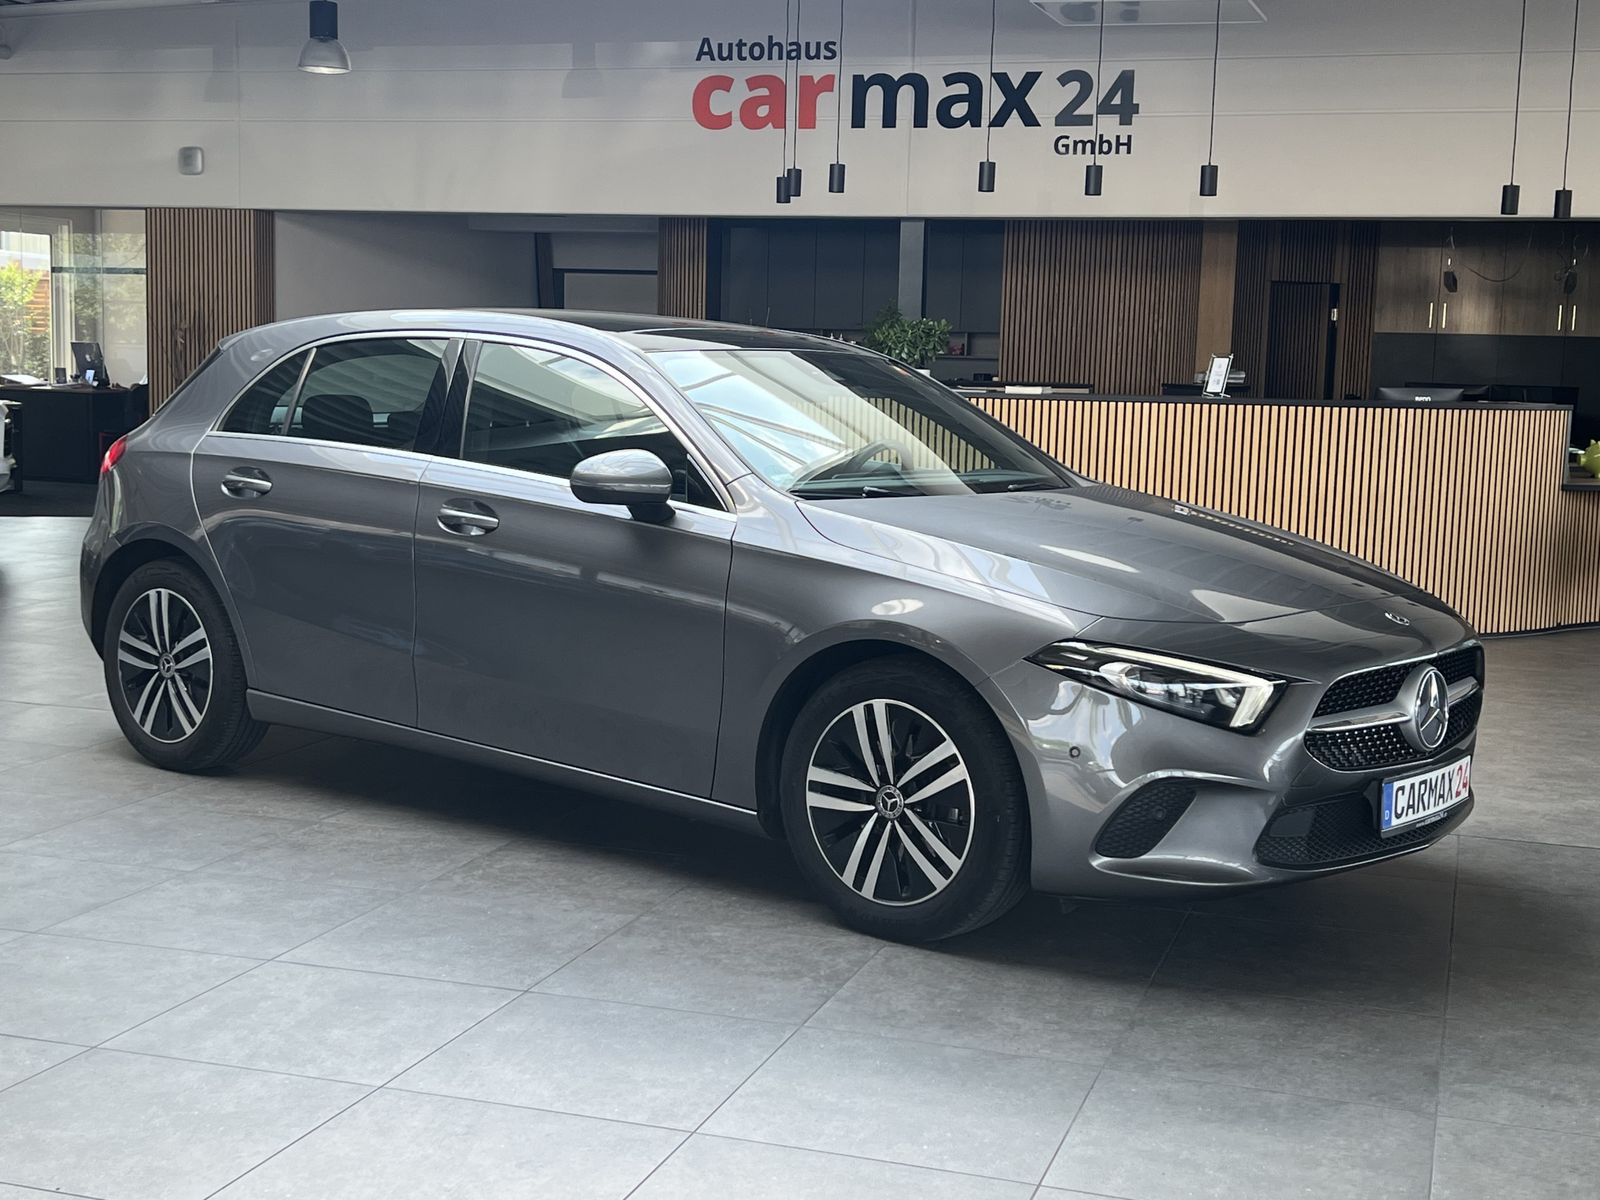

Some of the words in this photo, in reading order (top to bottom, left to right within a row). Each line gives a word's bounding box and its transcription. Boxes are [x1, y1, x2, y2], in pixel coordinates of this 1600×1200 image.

[695, 35, 838, 62] Autohaus
[1054, 69, 1140, 127] 24
[1053, 133, 1133, 156] GmbH
